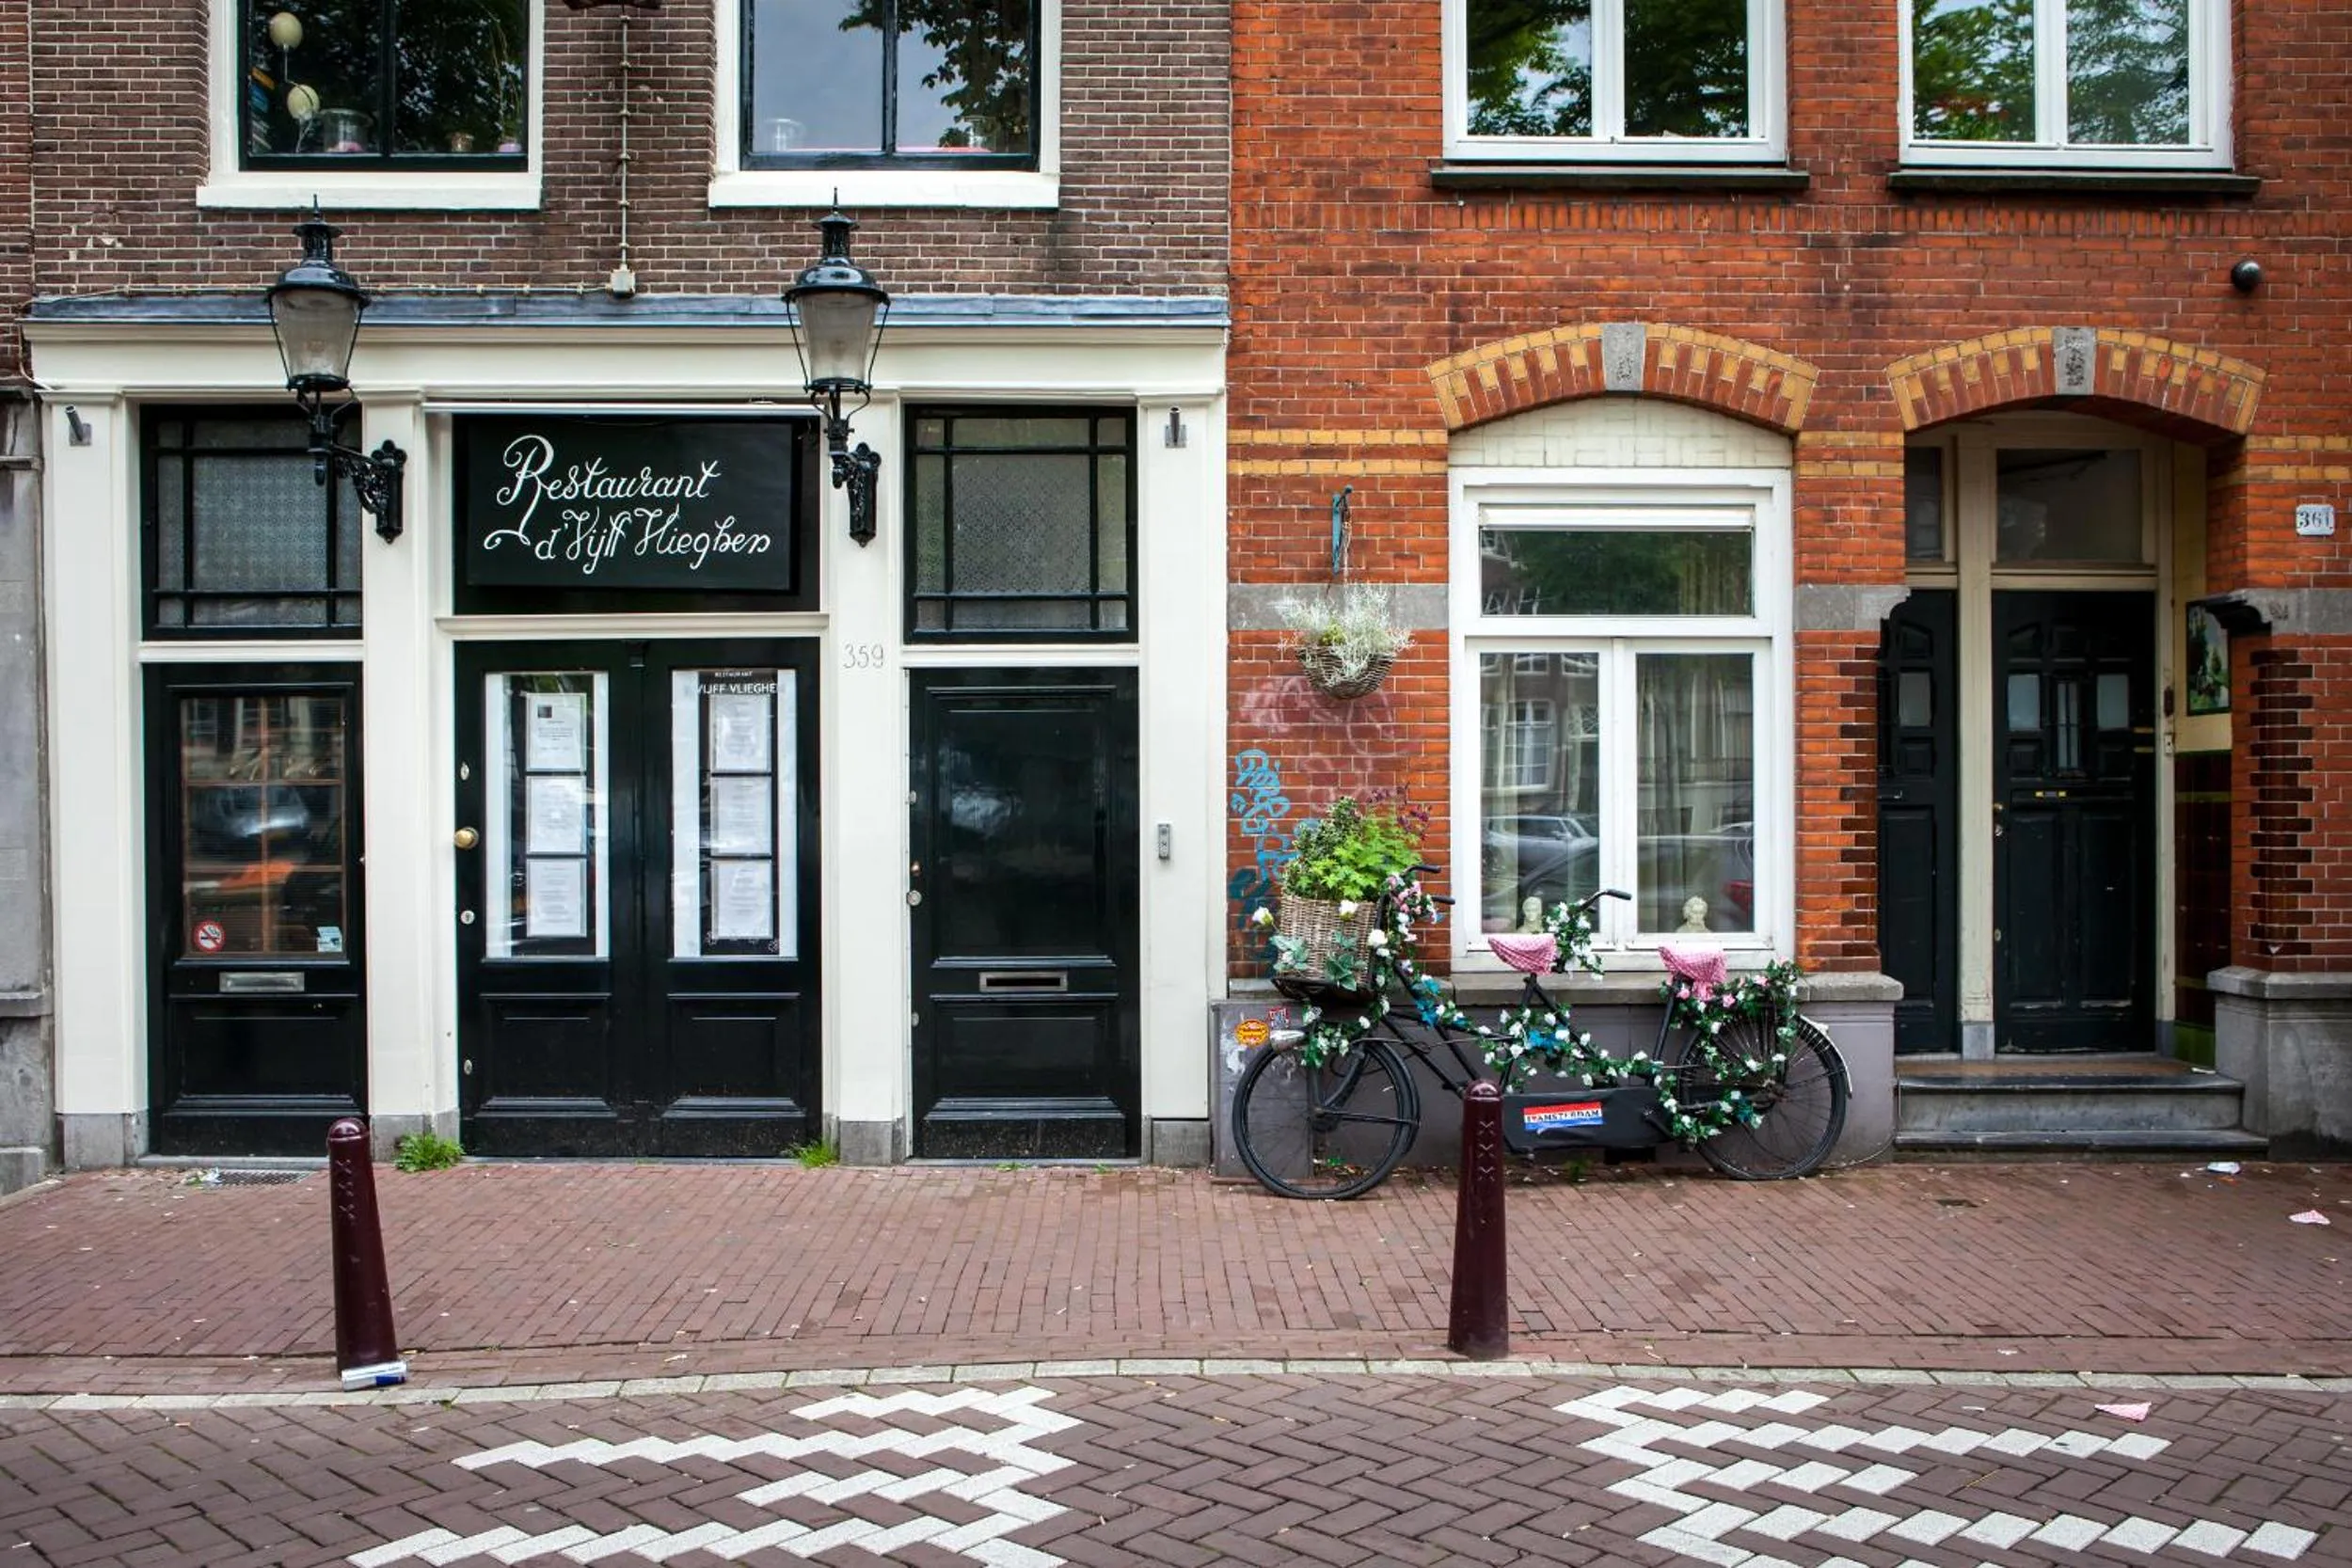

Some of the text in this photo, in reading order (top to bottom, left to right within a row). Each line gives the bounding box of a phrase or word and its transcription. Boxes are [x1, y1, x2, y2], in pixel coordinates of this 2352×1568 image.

[484, 434, 722, 549] Restaurant
[2299, 511, 2329, 527] 361
[634, 503, 771, 570] Vlieghen
[843, 643, 884, 669] 359
[1538, 1109, 1599, 1122] AMSTERDAM
